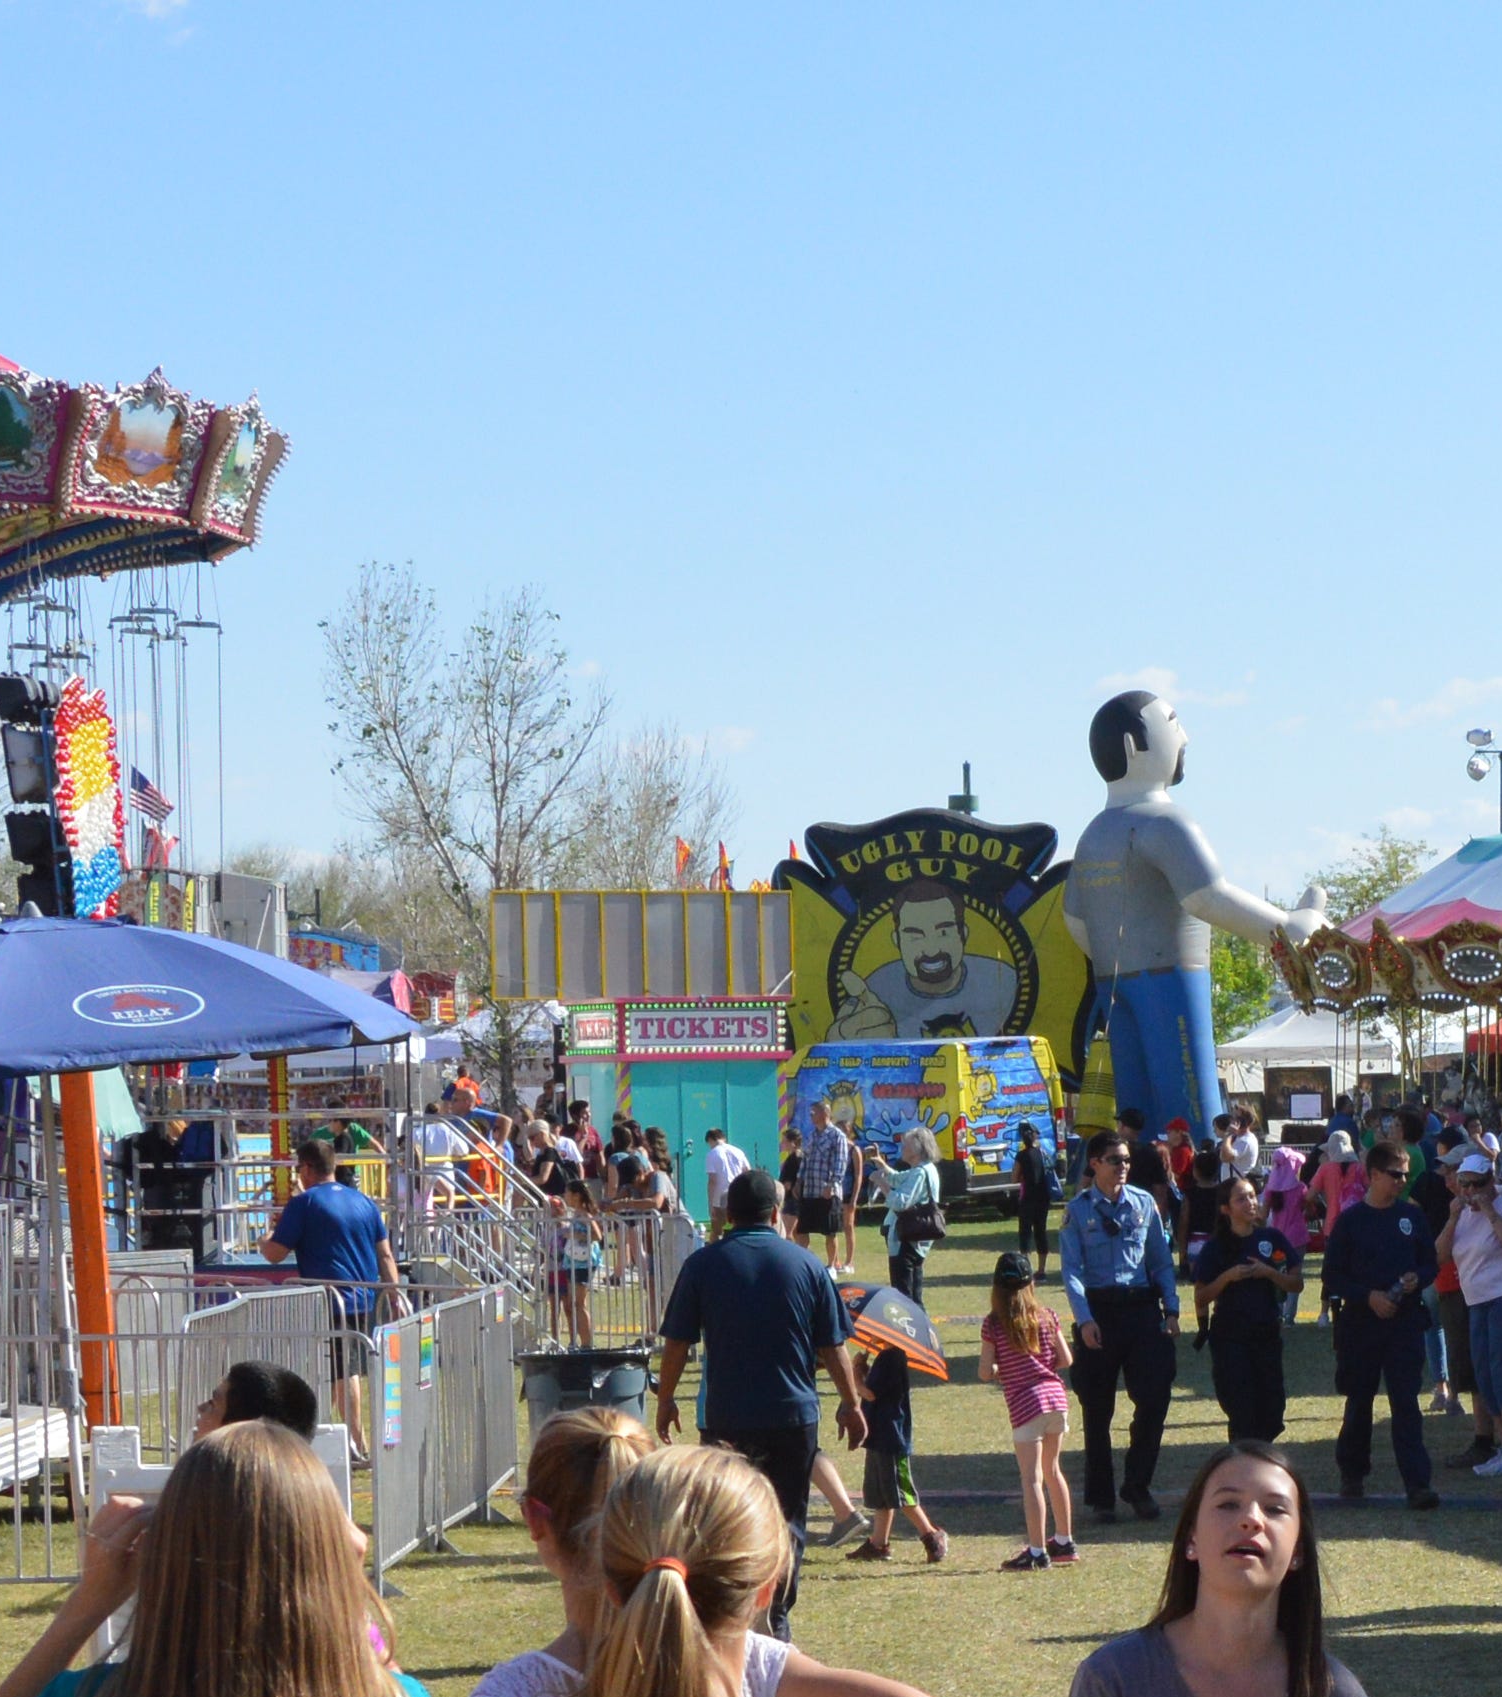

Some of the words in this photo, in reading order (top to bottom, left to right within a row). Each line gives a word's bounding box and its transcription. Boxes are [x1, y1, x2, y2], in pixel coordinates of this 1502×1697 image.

[836, 829, 927, 875] UGLY
[938, 829, 1026, 871] POOL
[884, 857, 981, 883] GUY
[110, 1007, 175, 1021] RELAX
[633, 1016, 769, 1040] TICKETS
